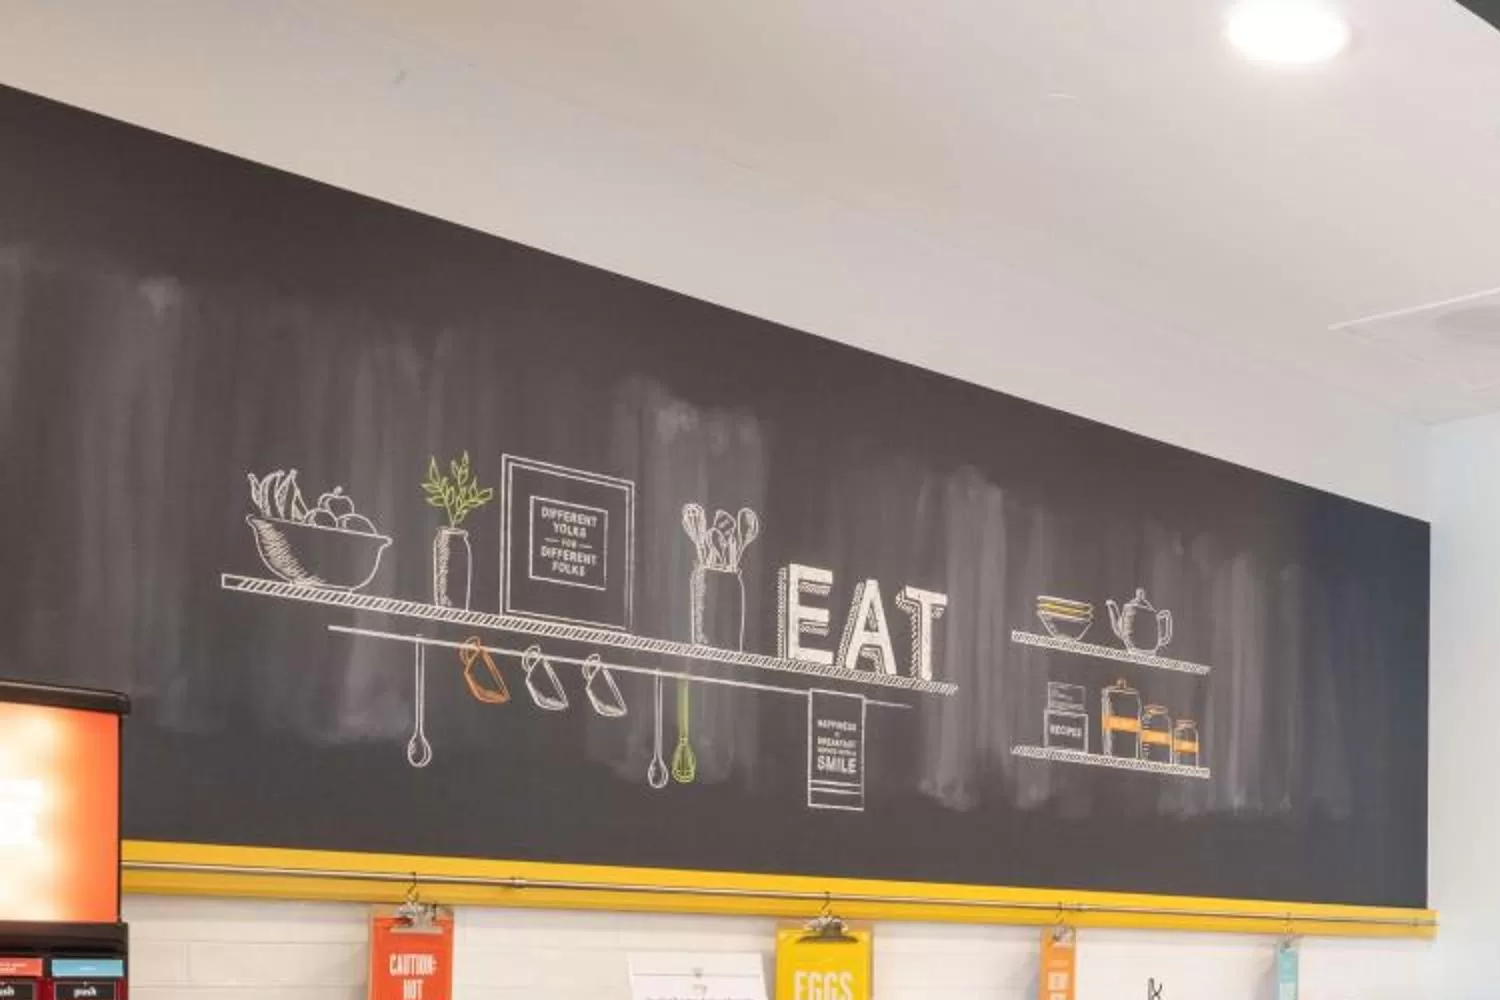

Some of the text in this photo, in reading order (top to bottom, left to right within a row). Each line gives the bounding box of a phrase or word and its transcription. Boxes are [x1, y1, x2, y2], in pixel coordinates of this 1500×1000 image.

[541, 505, 598, 528] DIFFERENT
[553, 521, 587, 539] YOLKS
[541, 545, 598, 567] DIFFERENT
[778, 563, 948, 681] EAT
[817, 755, 857, 774] SMILE
[73, 985, 97, 999] push
[403, 979, 424, 1000] HOT
